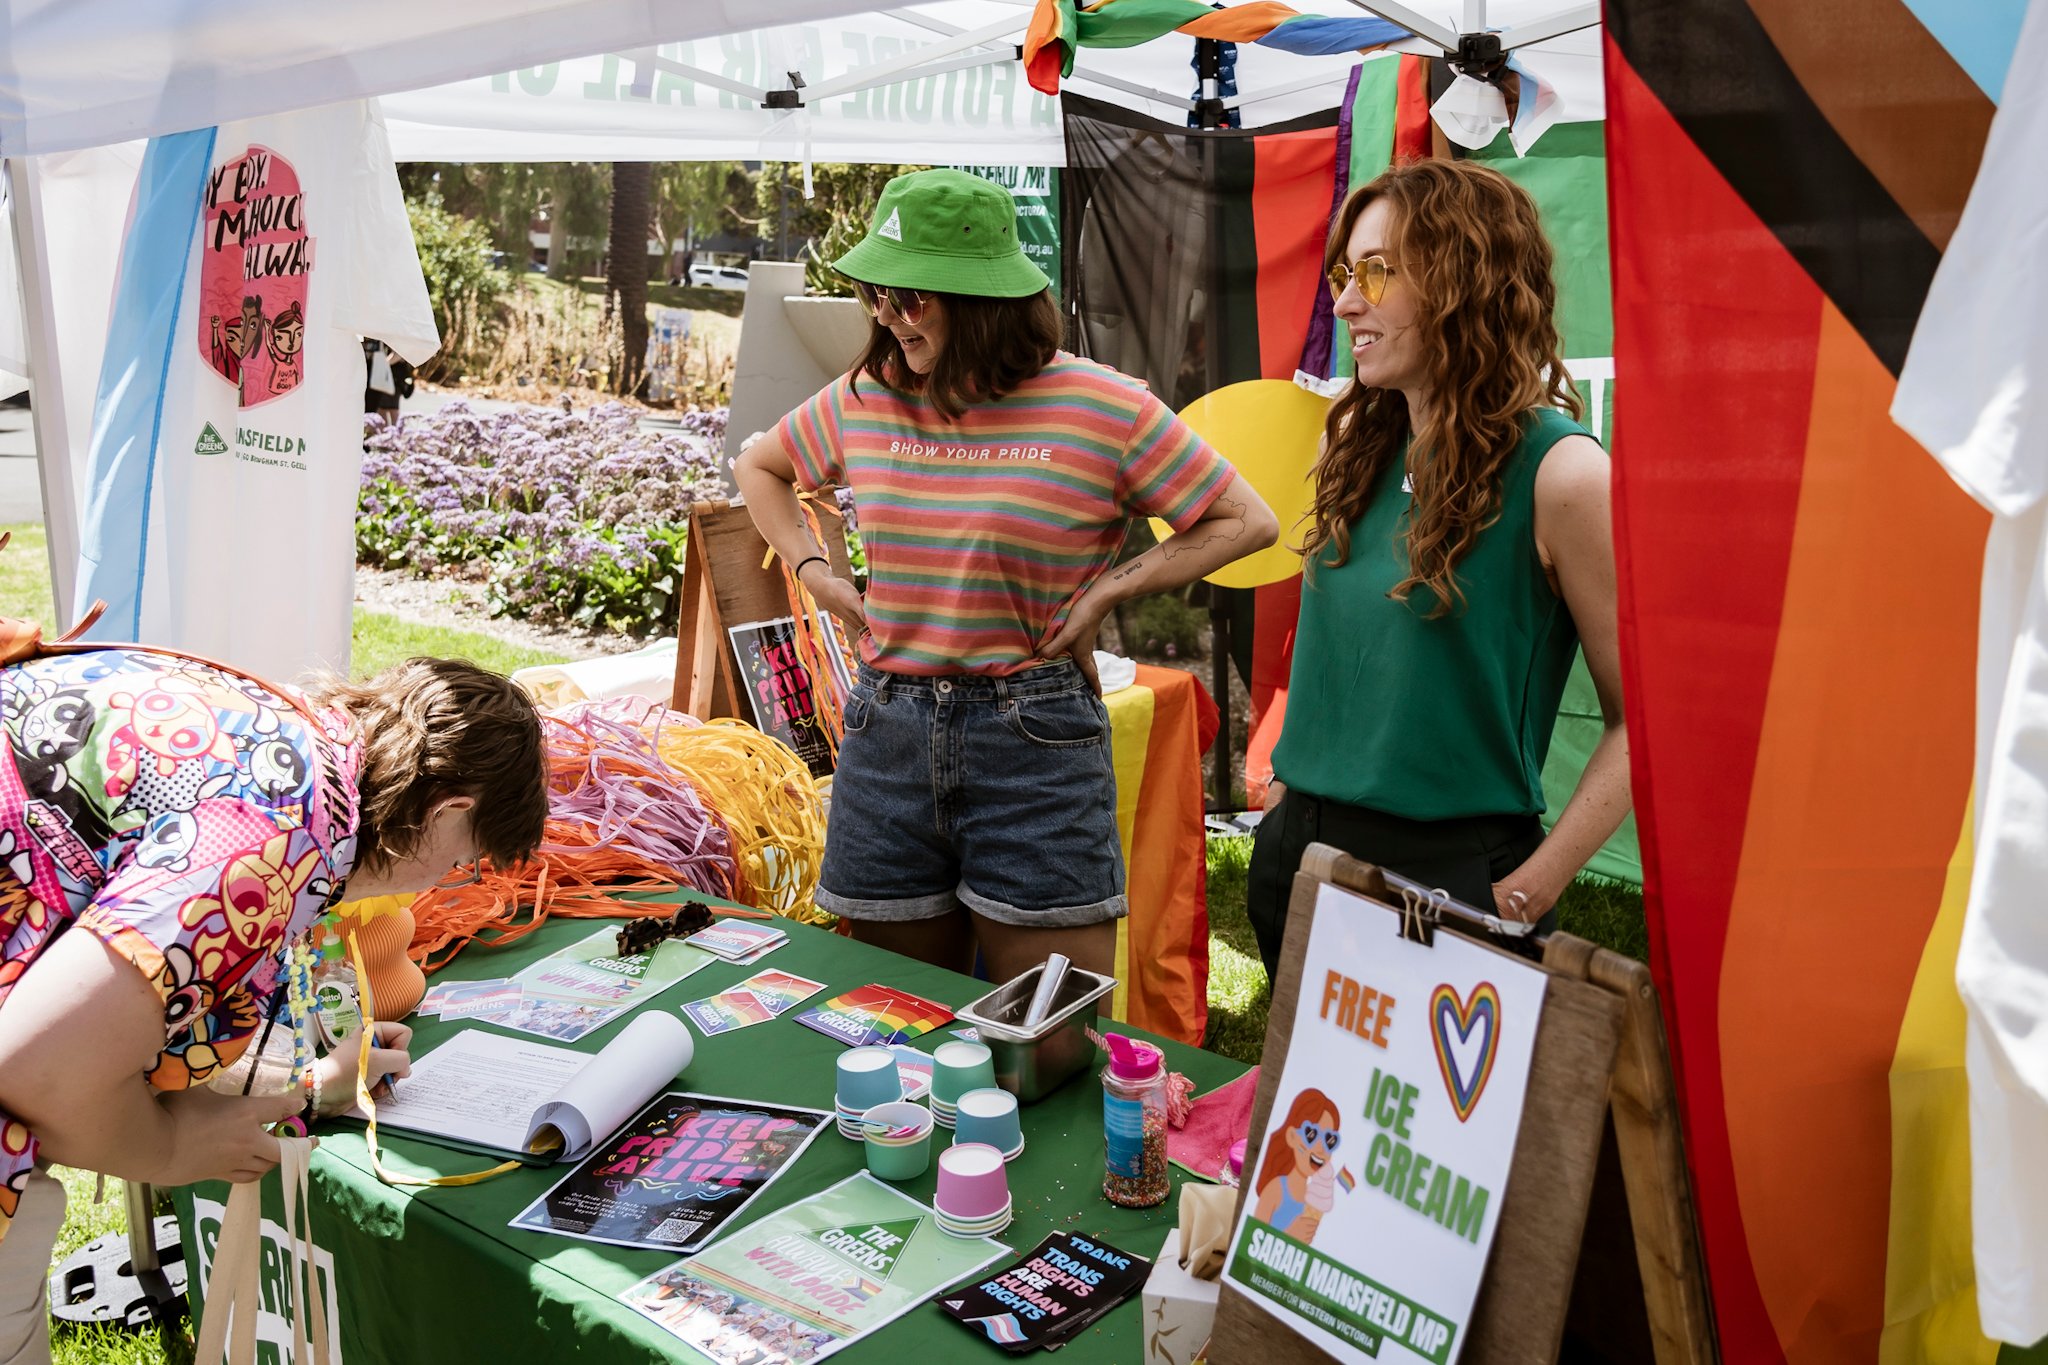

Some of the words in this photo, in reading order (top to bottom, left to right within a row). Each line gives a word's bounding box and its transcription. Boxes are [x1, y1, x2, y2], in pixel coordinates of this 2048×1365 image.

[890, 441, 939, 457] SHOW
[946, 447, 989, 460] YOUR
[997, 448, 1052, 461] PRIDE
[589, 957, 646, 976] GREENS
[457, 999, 505, 1014] GREENS
[817, 1011, 870, 1036] GREENS
[1320, 968, 1396, 1049] FREE
[1363, 1067, 1419, 1140] ICE
[674, 1117, 799, 1141] KEEP
[617, 1135, 756, 1164] PRIDE
[607, 1156, 757, 1187] ALIVE
[1365, 1133, 1490, 1244] CREAM
[819, 1227, 894, 1271] GREENS
[859, 1224, 904, 1250] THE
[1070, 1236, 1131, 1271] TRANS
[1010, 1267, 1054, 1292] ARE
[1025, 1257, 1095, 1298] RIGHTS
[1042, 1246, 1105, 1286] TRANS
[791, 1276, 867, 1315] PRIDE
[979, 1281, 1047, 1320] RIGHTS
[995, 1274, 1068, 1316] HUMAN
[1247, 1228, 1308, 1282] SARAH
[1305, 1257, 1412, 1337] MANSFIELD
[1409, 1312, 1450, 1355] MP
[1250, 1273, 1284, 1297] MEMBER
[1283, 1289, 1299, 1305] FOR
[1298, 1298, 1336, 1326] WESTERN
[1335, 1316, 1374, 1349] VICTORIA
